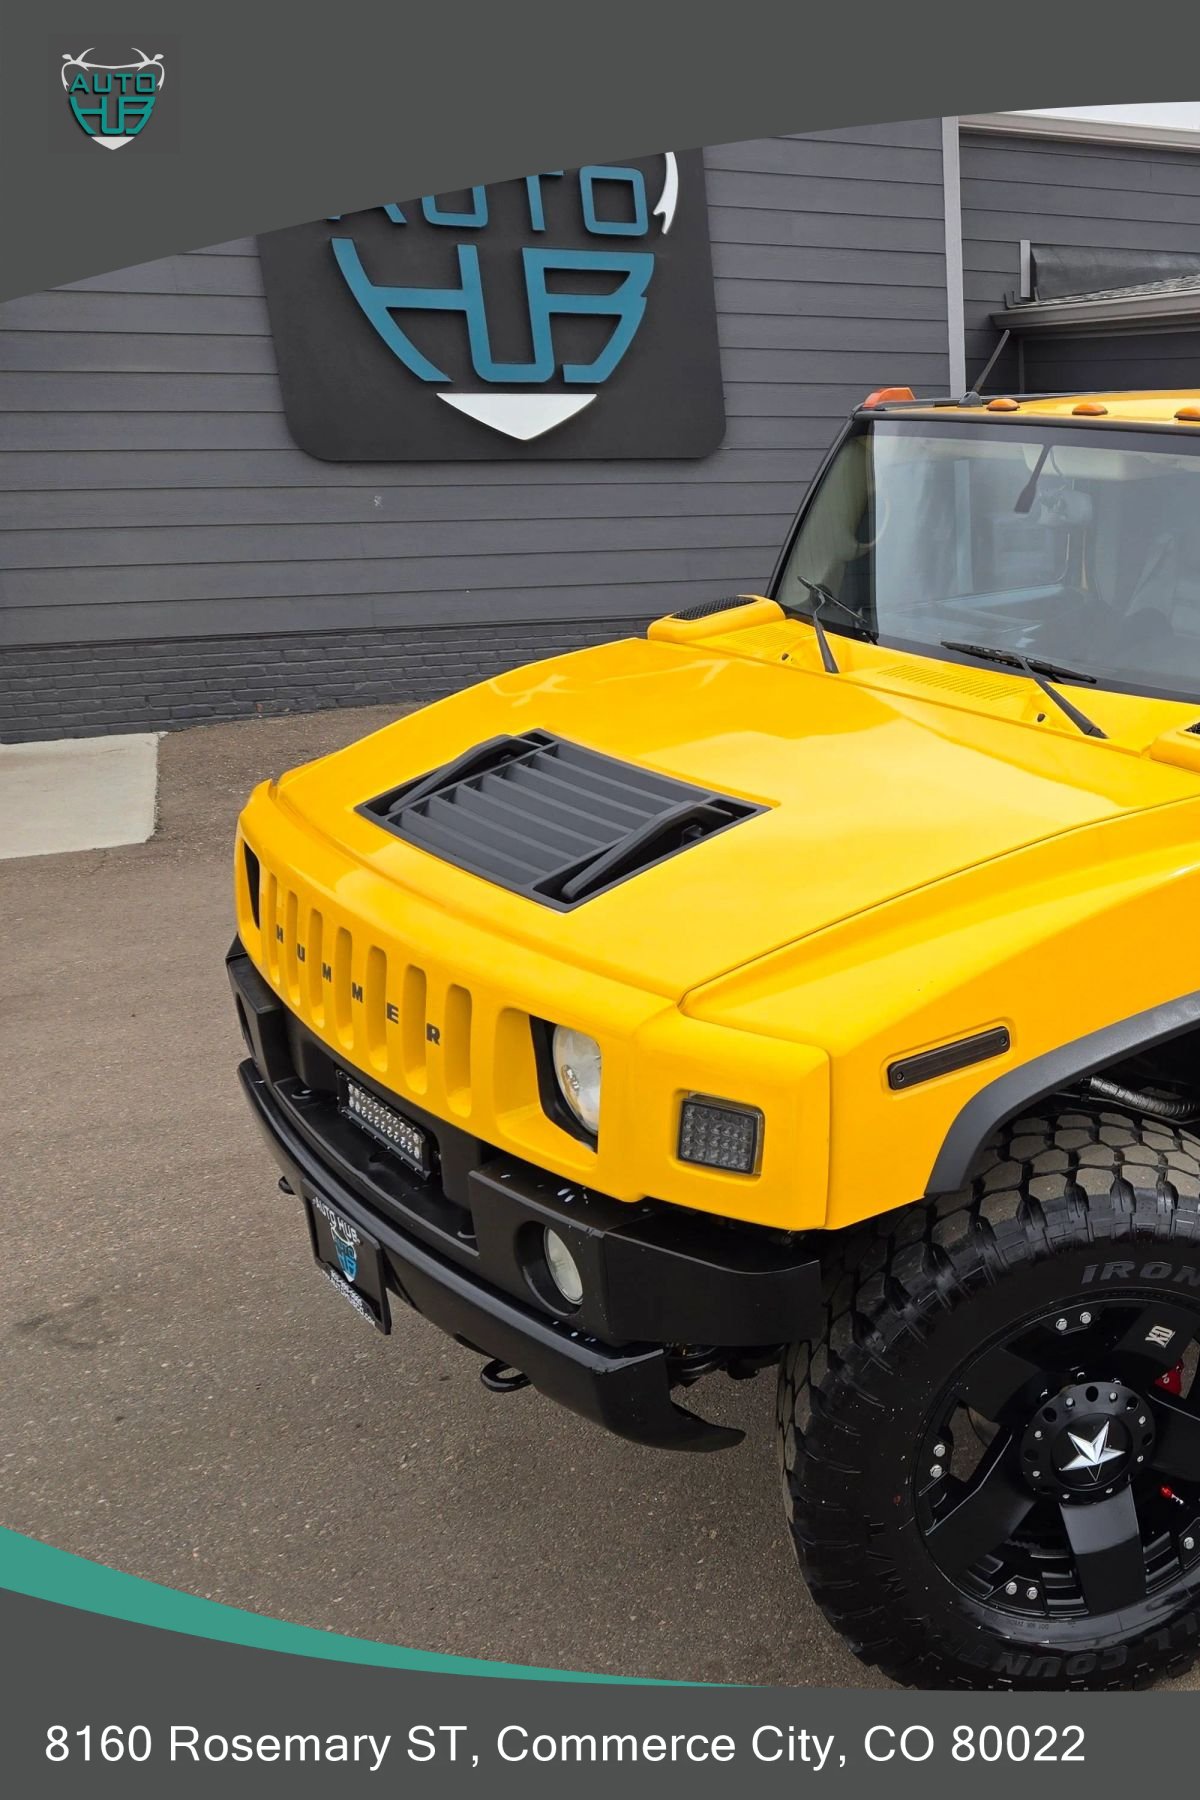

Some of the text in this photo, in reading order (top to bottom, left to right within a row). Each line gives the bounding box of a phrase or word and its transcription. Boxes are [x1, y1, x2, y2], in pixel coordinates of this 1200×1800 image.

[326, 165, 648, 236] UTO
[331, 237, 655, 383] HUB
[276, 924, 441, 1046] HUMMER
